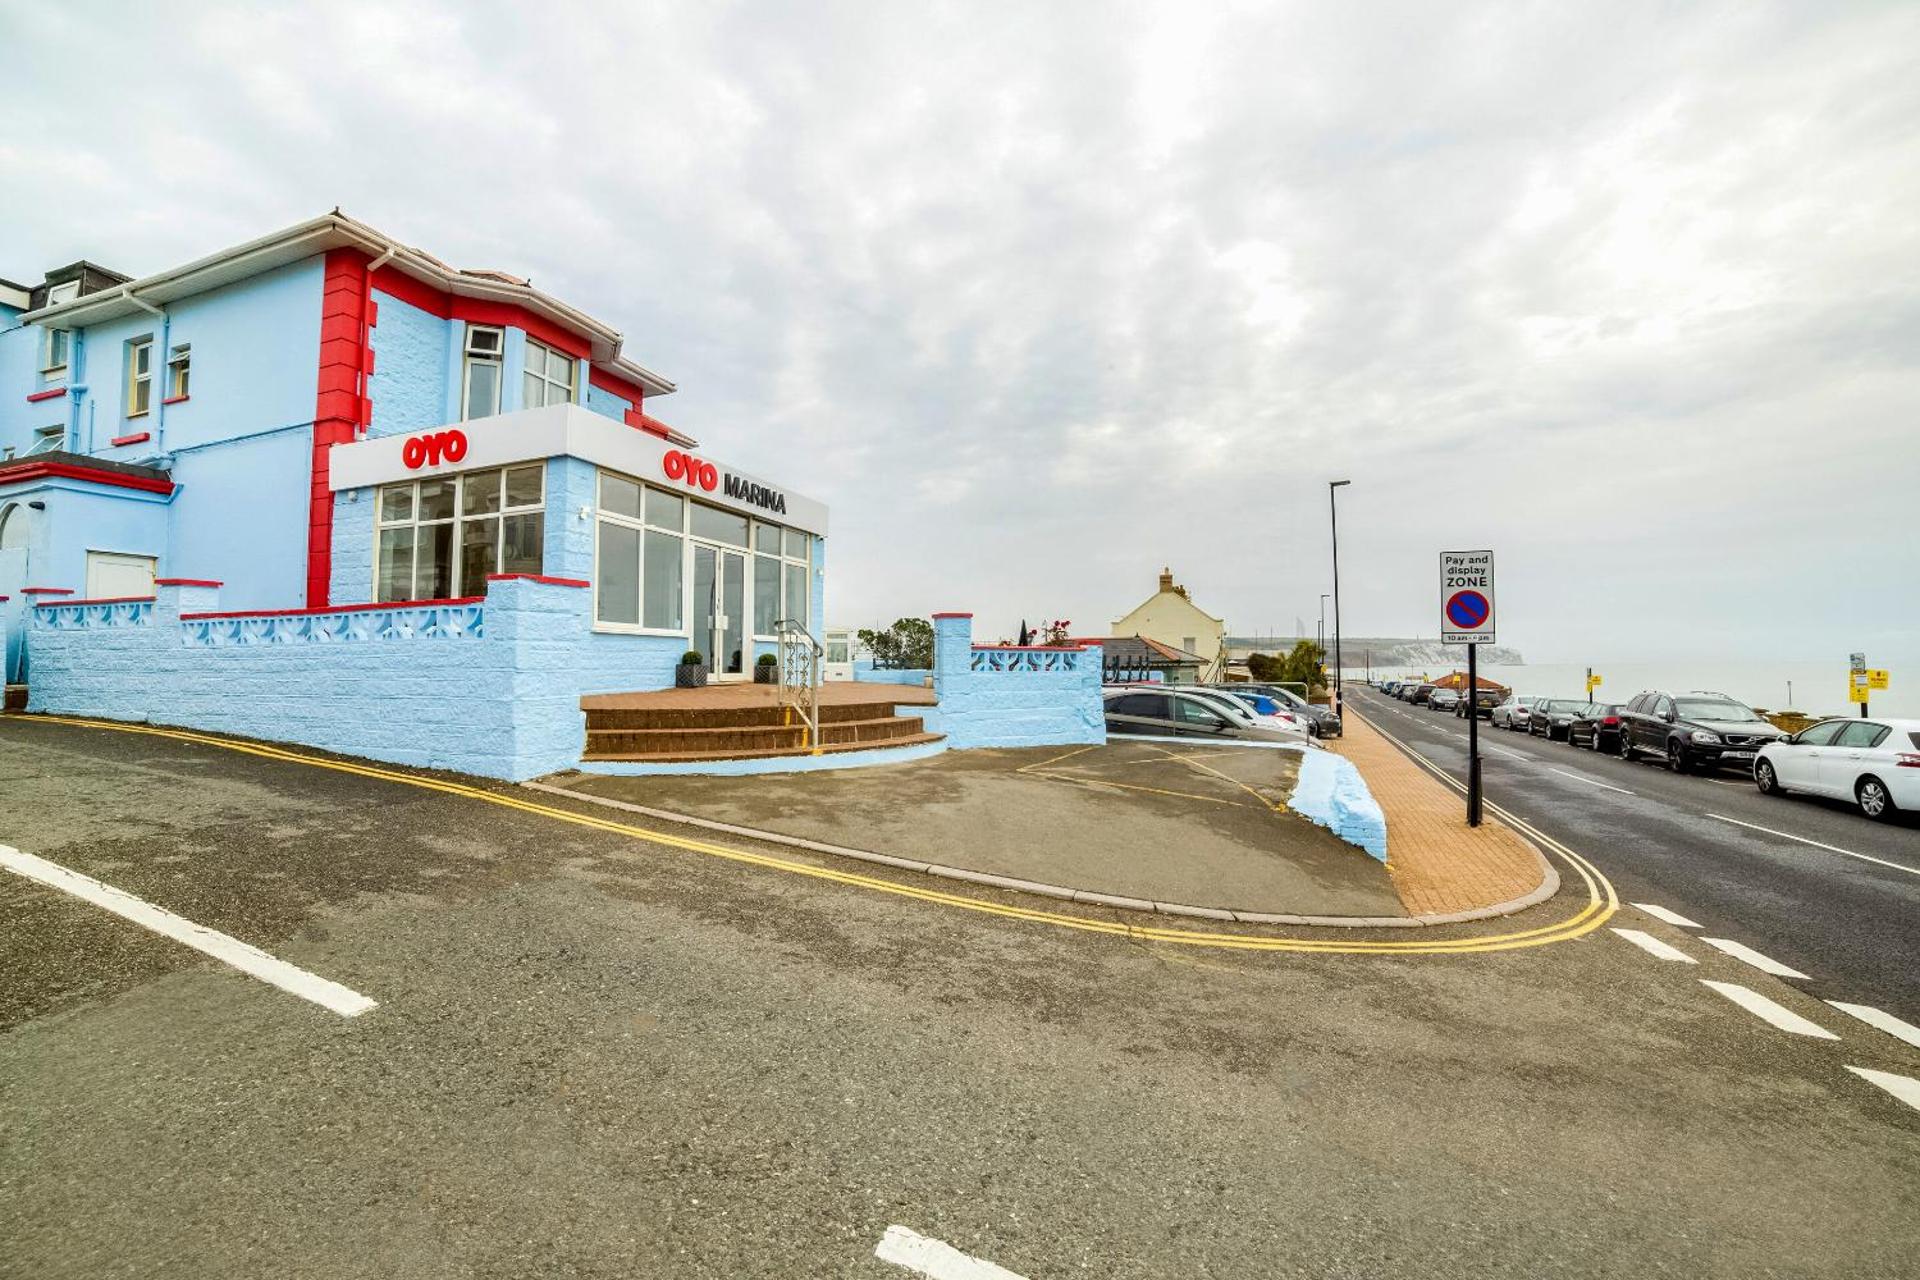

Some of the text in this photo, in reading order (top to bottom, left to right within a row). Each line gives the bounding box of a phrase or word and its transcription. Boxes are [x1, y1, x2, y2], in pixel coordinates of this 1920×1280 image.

[403, 430, 467, 468] OYO
[663, 450, 786, 515] OYO MARINA
[1446, 556, 1465, 565] Pay
[1447, 567, 1485, 575] display
[1447, 577, 1487, 587] ZONE
